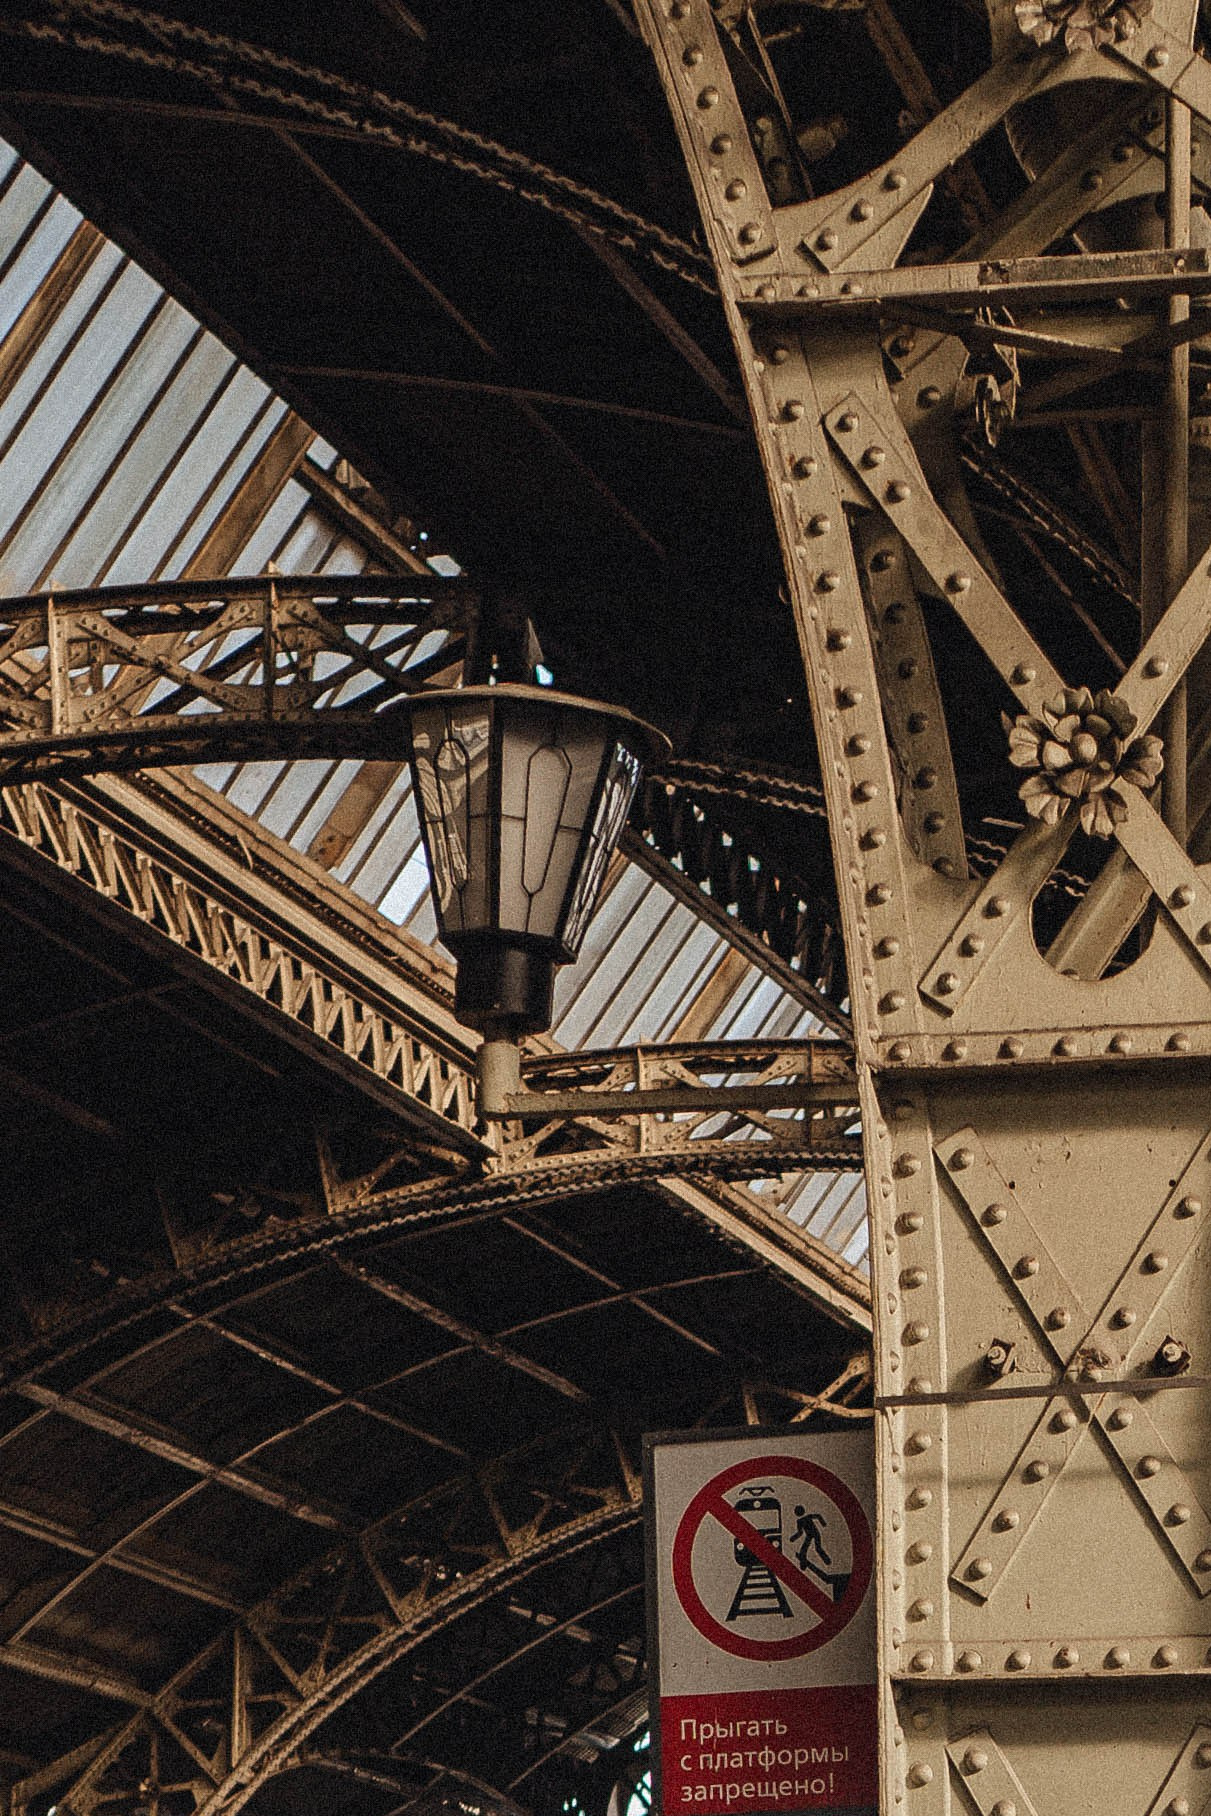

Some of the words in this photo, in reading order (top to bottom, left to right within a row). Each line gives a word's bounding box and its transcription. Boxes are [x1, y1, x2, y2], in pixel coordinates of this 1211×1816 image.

[680, 1718, 788, 1745] Прыгать
[680, 1755, 692, 1771] с
[699, 1745, 849, 1772] платформы
[680, 1773, 835, 1805] запрещено!
